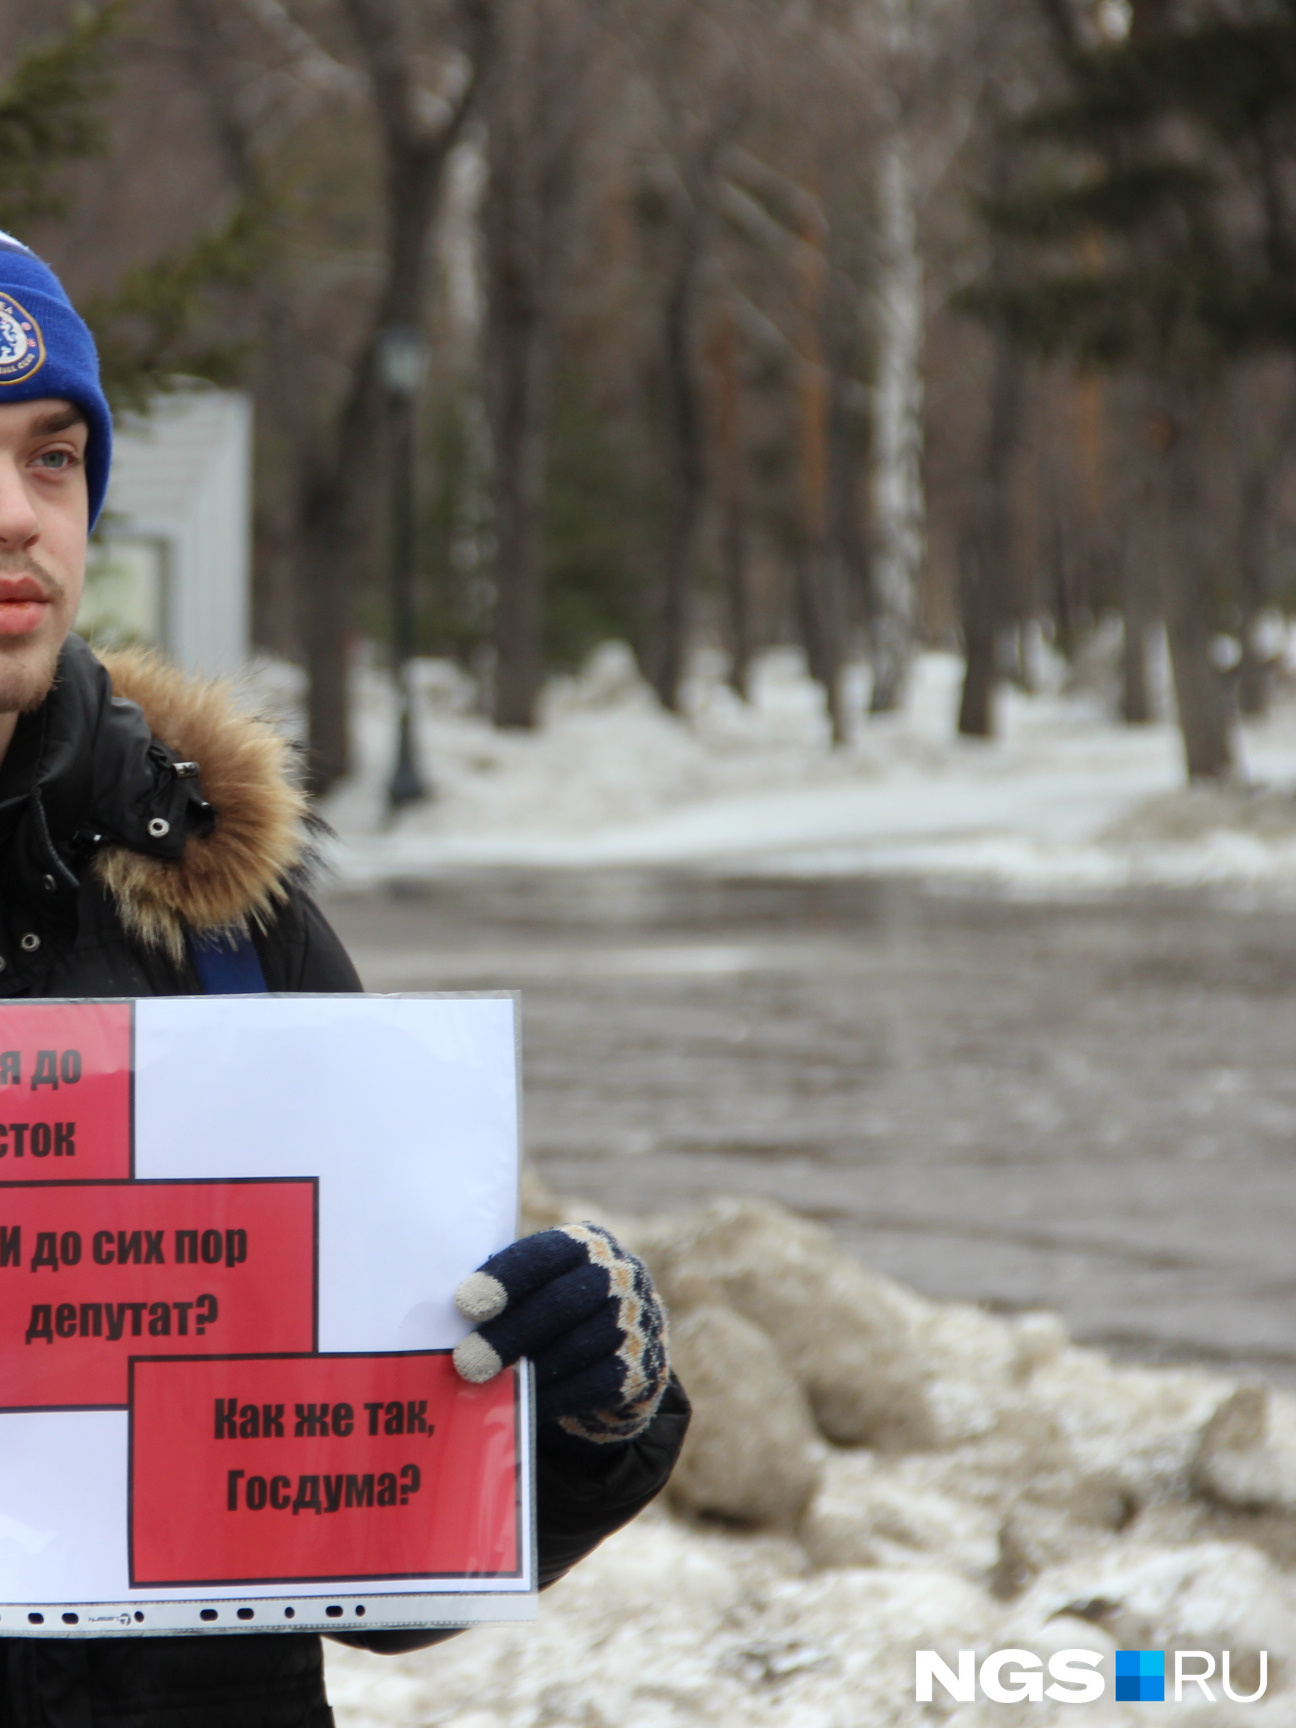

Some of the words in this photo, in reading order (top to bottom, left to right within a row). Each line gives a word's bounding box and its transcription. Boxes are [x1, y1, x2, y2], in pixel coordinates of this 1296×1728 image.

[29, 1049, 82, 1091] до
[30, 1230, 82, 1273] до
[92, 1229, 165, 1266] сих
[174, 1227, 248, 1268] пор
[25, 1293, 219, 1345] депутат?
[213, 1398, 285, 1440] Как
[293, 1402, 354, 1438] же
[363, 1399, 435, 1438] так,
[226, 1463, 421, 1516] Госдума?
